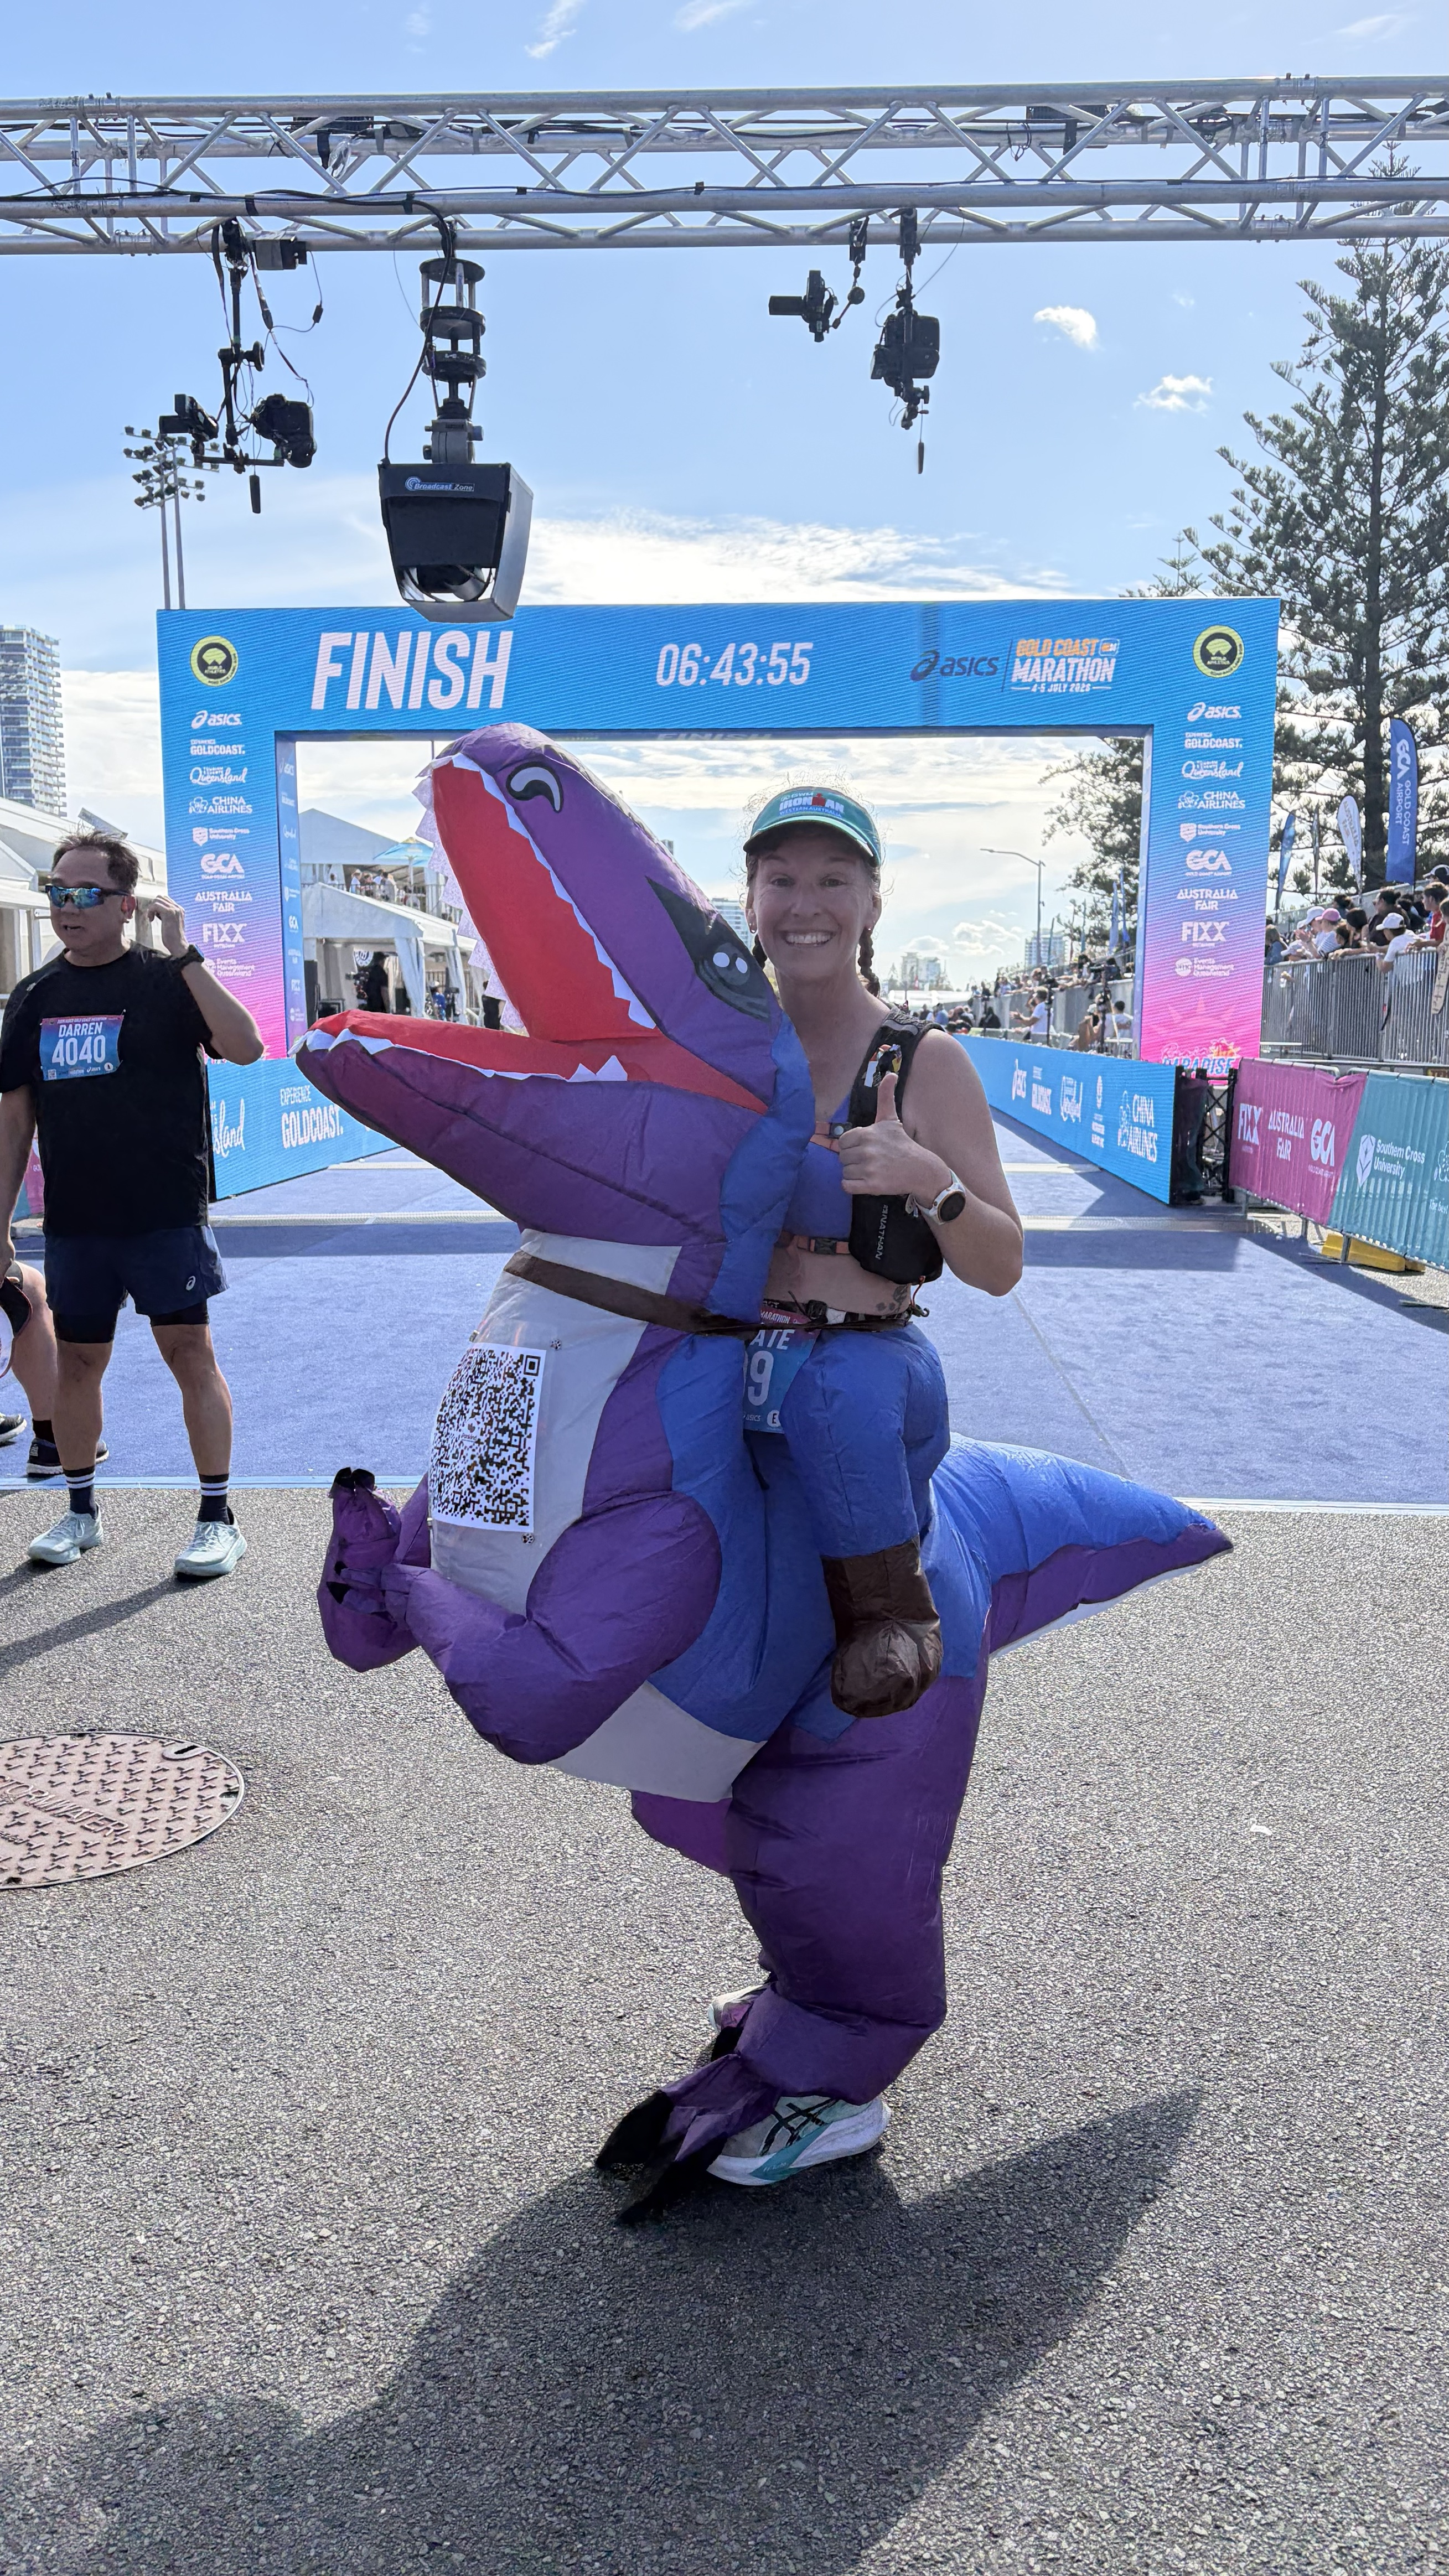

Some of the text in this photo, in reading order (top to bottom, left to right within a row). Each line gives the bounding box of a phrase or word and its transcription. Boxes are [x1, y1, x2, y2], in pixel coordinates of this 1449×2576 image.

[1016, 639, 1052, 657] GOLD
[1053, 638, 1099, 656] COAST
[310, 631, 514, 710] FINISH
[656, 642, 814, 686] 06:43:55
[1011, 657, 1116, 682] MARATHON
[1047, 683, 1068, 692] JULY
[1182, 760, 1244, 779] Queensland
[1396, 739, 1411, 780] GCA
[189, 767, 247, 785] Queensland
[213, 796, 246, 805] CHINA
[1197, 800, 1245, 809] AIRLINES
[1203, 791, 1239, 800] CHINA
[1395, 782, 1404, 825] AIRPORT
[207, 805, 252, 814] AIRLINES
[780, 806, 806, 815] WESTERN
[1402, 811, 1411, 845] COAST
[201, 853, 245, 873] GCA
[1186, 849, 1232, 870] GCA
[195, 891, 252, 901] AUSTRALIA
[1177, 889, 1238, 899] AUSTRALIA
[213, 902, 235, 912] FAIR
[1195, 900, 1218, 910] FAIR
[203, 923, 247, 943] FIXX
[1182, 921, 1230, 941] FIXX
[59, 1022, 103, 1038] DARREN
[51, 1035, 106, 1066] 4040
[280, 1085, 312, 1106] EXPERIENCE
[1132, 1094, 1155, 1128] CHINA
[1238, 1103, 1262, 1145] FIXX
[1268, 1110, 1304, 1139] AUSTRALIA
[1127, 1125, 1158, 1163] AIRLINES
[1277, 1137, 1291, 1161] FAIR
[1311, 1118, 1335, 1167] GCA
[1376, 1139, 1425, 1164] Southern Cross
[1374, 1156, 1405, 1180] University
[760, 1310, 790, 1324] MARATHON
[749, 1329, 795, 1350] ATE
[748, 1350, 774, 1406] 9
[772, 1413, 777, 1424] E
